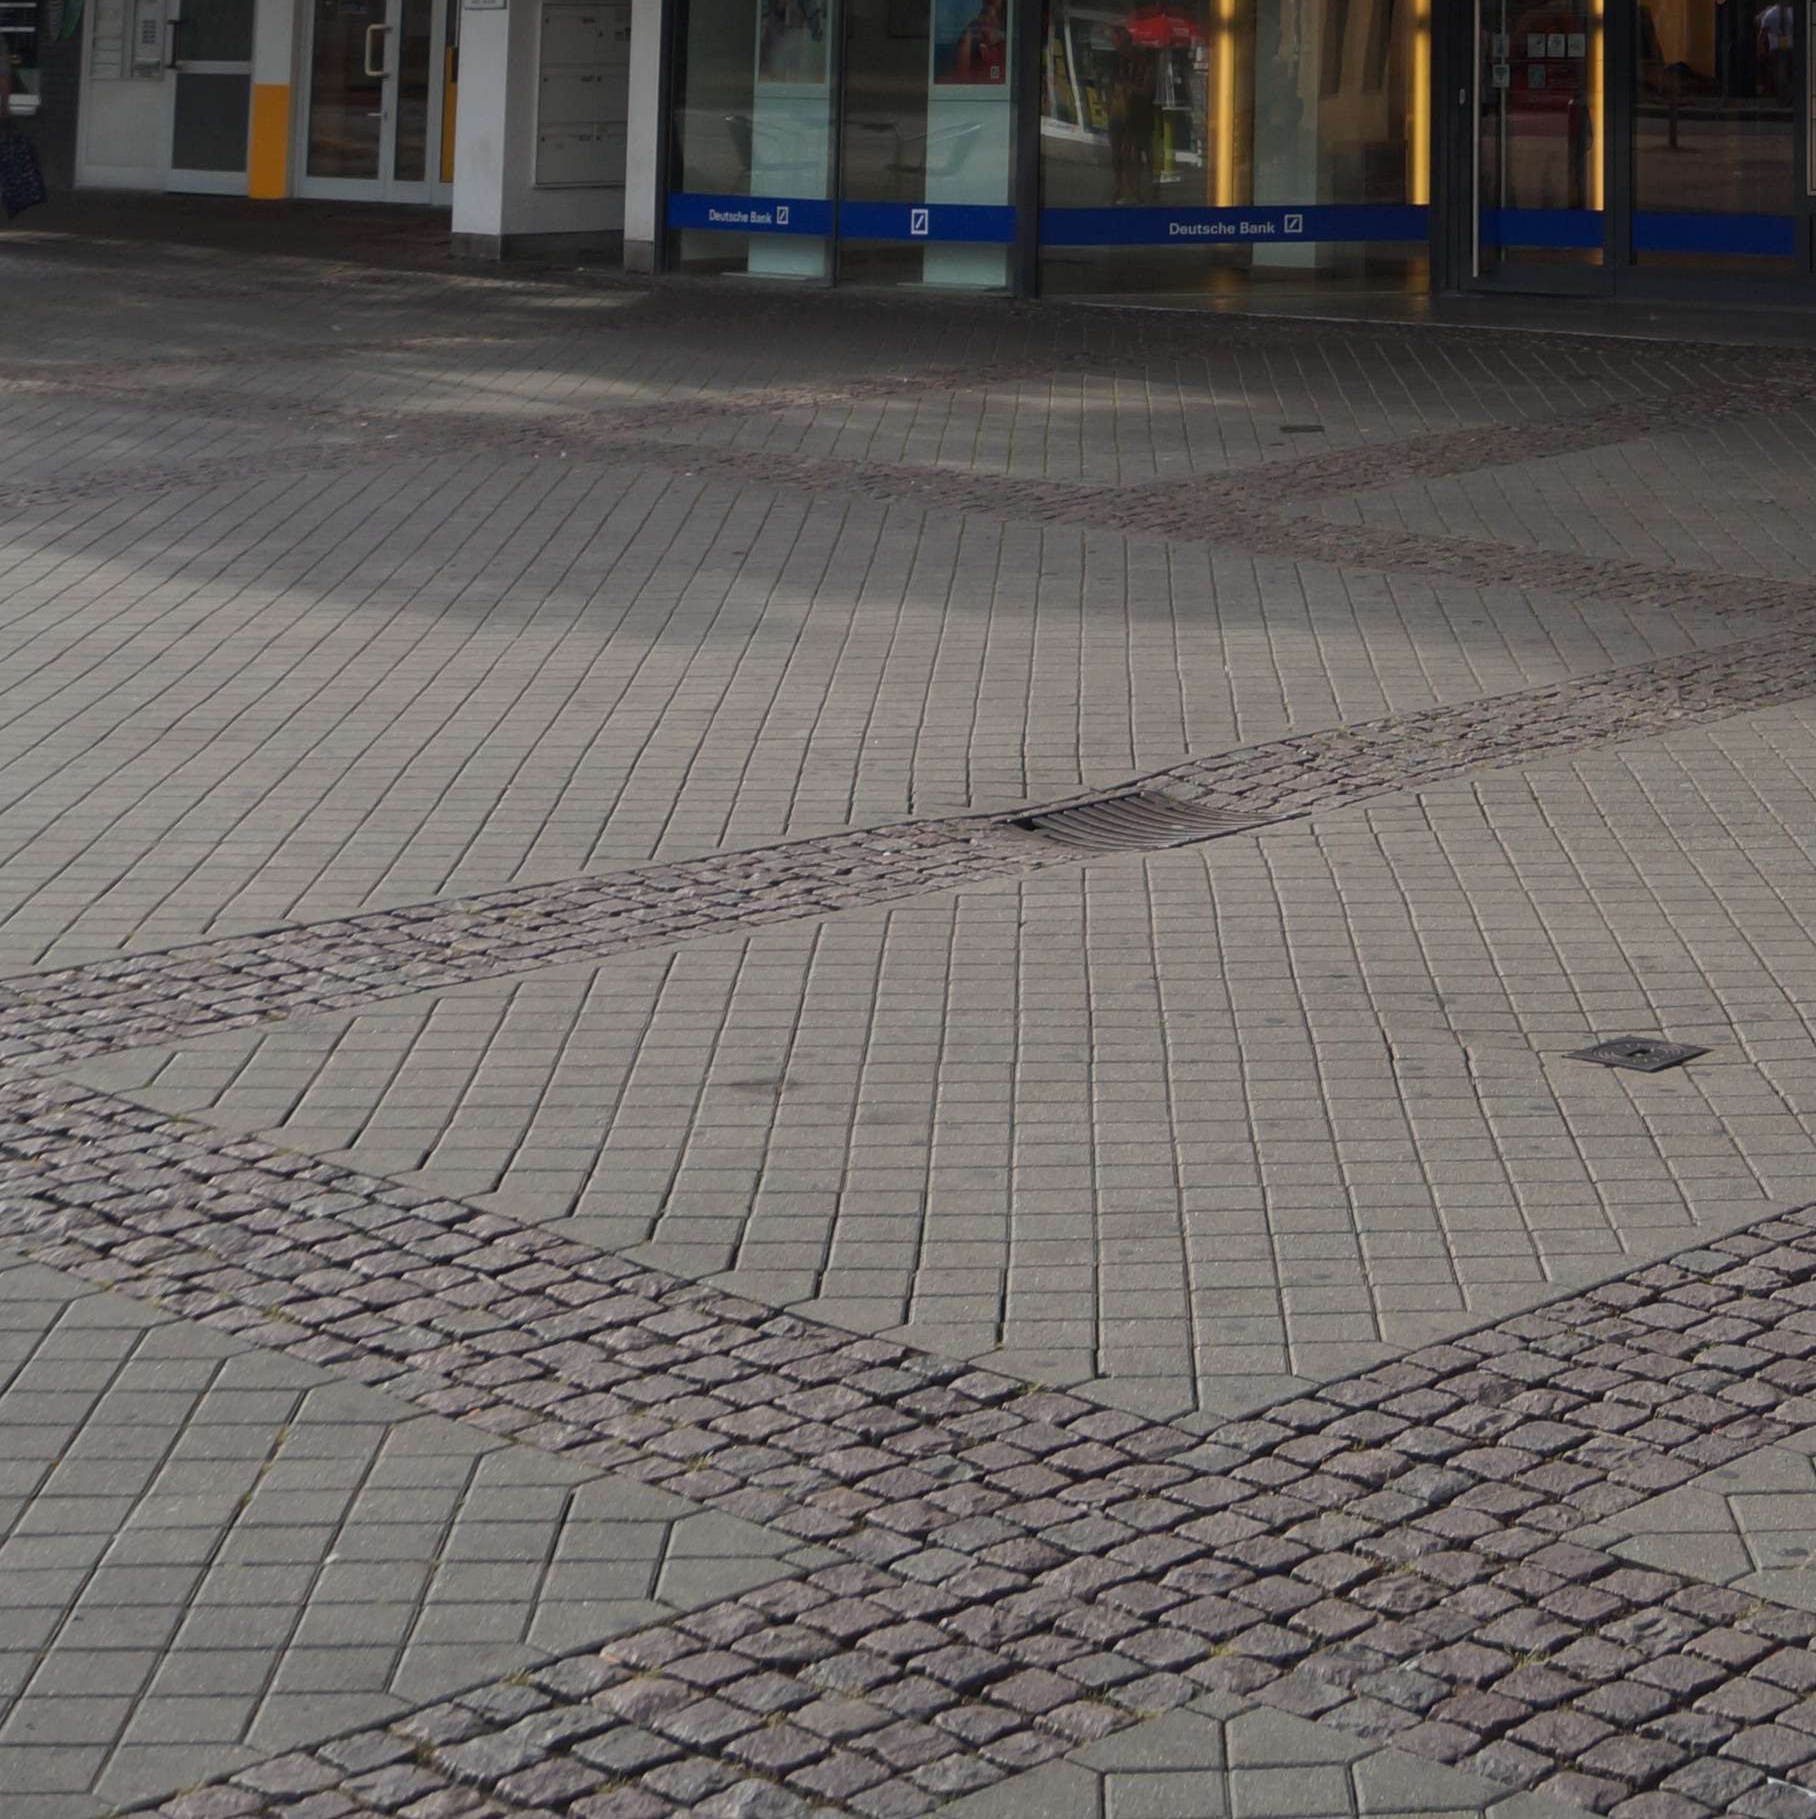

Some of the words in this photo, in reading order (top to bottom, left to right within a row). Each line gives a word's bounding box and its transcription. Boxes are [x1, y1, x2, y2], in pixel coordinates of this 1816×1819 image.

[708, 208, 749, 223] Deutsche
[750, 210, 772, 224] Bank
[1168, 222, 1236, 235] Deutsche
[1239, 221, 1275, 235] Bank
